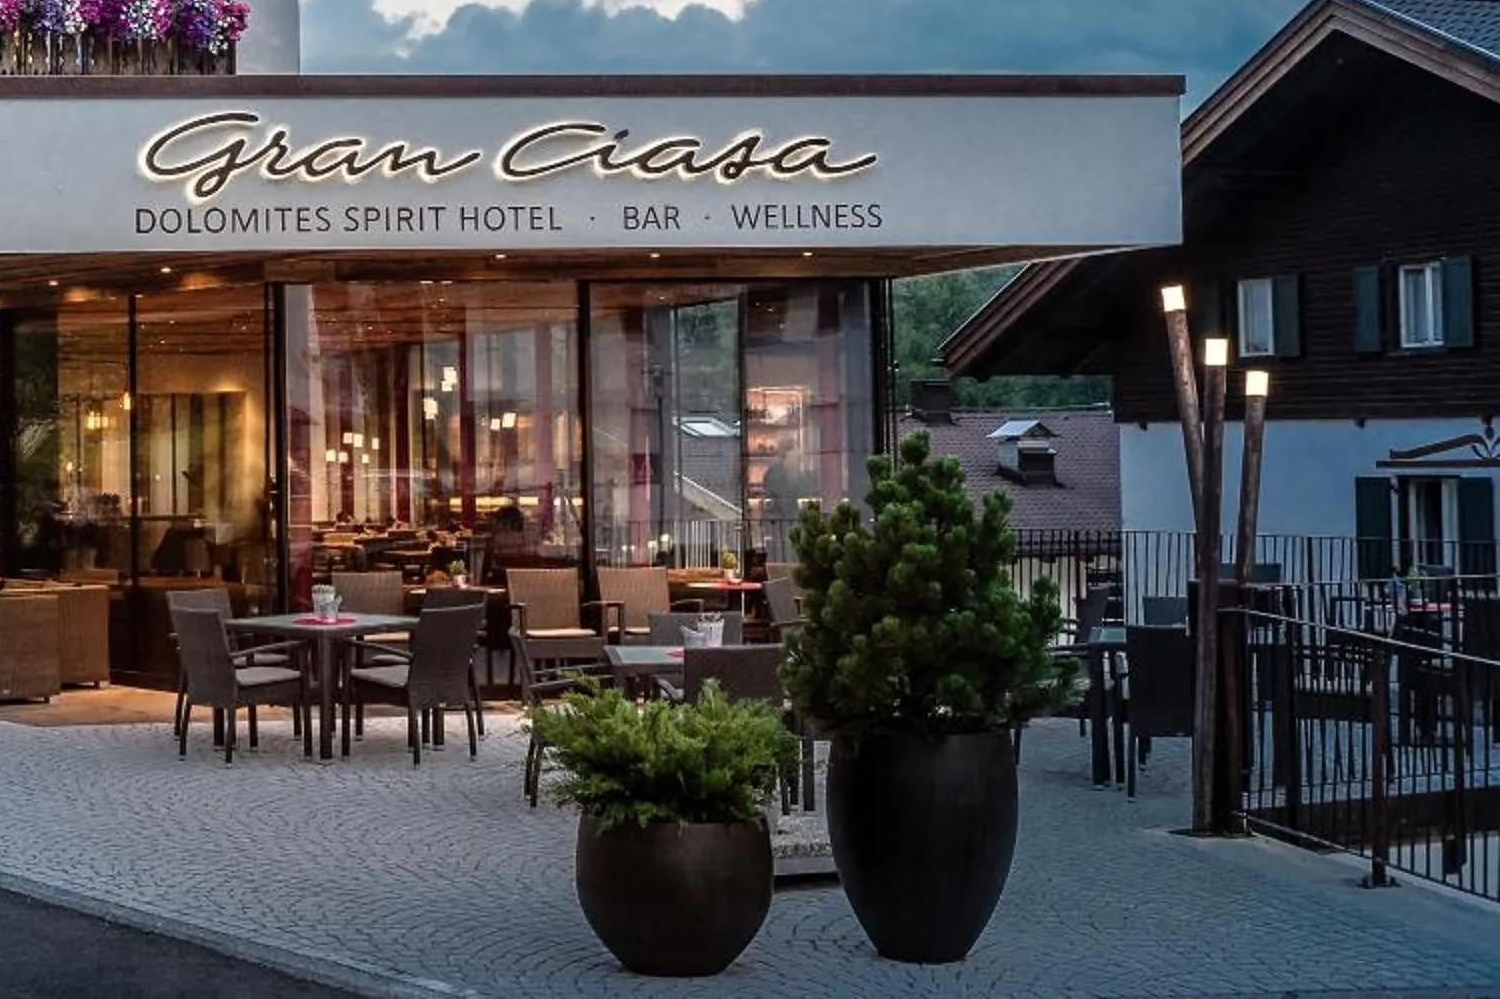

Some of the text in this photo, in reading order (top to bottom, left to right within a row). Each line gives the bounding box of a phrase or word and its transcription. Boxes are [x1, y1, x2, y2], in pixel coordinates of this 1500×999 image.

[145, 112, 877, 198] Gran Ciasa
[134, 204, 883, 234] DOLOMITES SPIRIT HOTEL BAR WELLNESS
